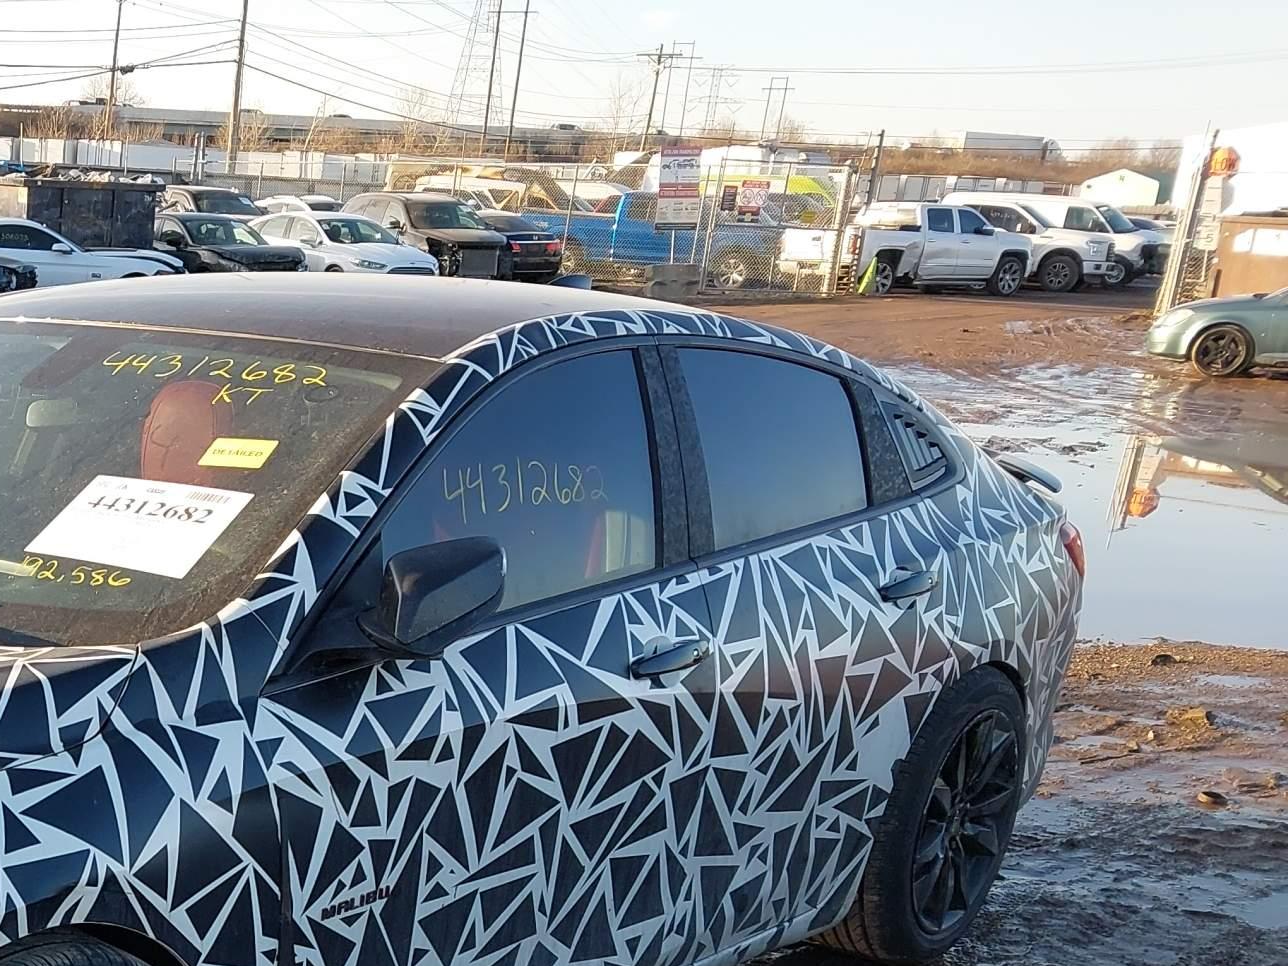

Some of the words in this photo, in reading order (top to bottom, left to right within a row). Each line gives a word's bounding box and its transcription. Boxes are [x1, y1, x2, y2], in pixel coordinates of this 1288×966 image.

[102, 351, 328, 386] 44312682
[212, 383, 275, 405] KT
[211, 447, 264, 458] DETAILED
[443, 456, 609, 525] 44312682
[88, 495, 214, 524] 44312682
[320, 885, 393, 921] MALIBU
